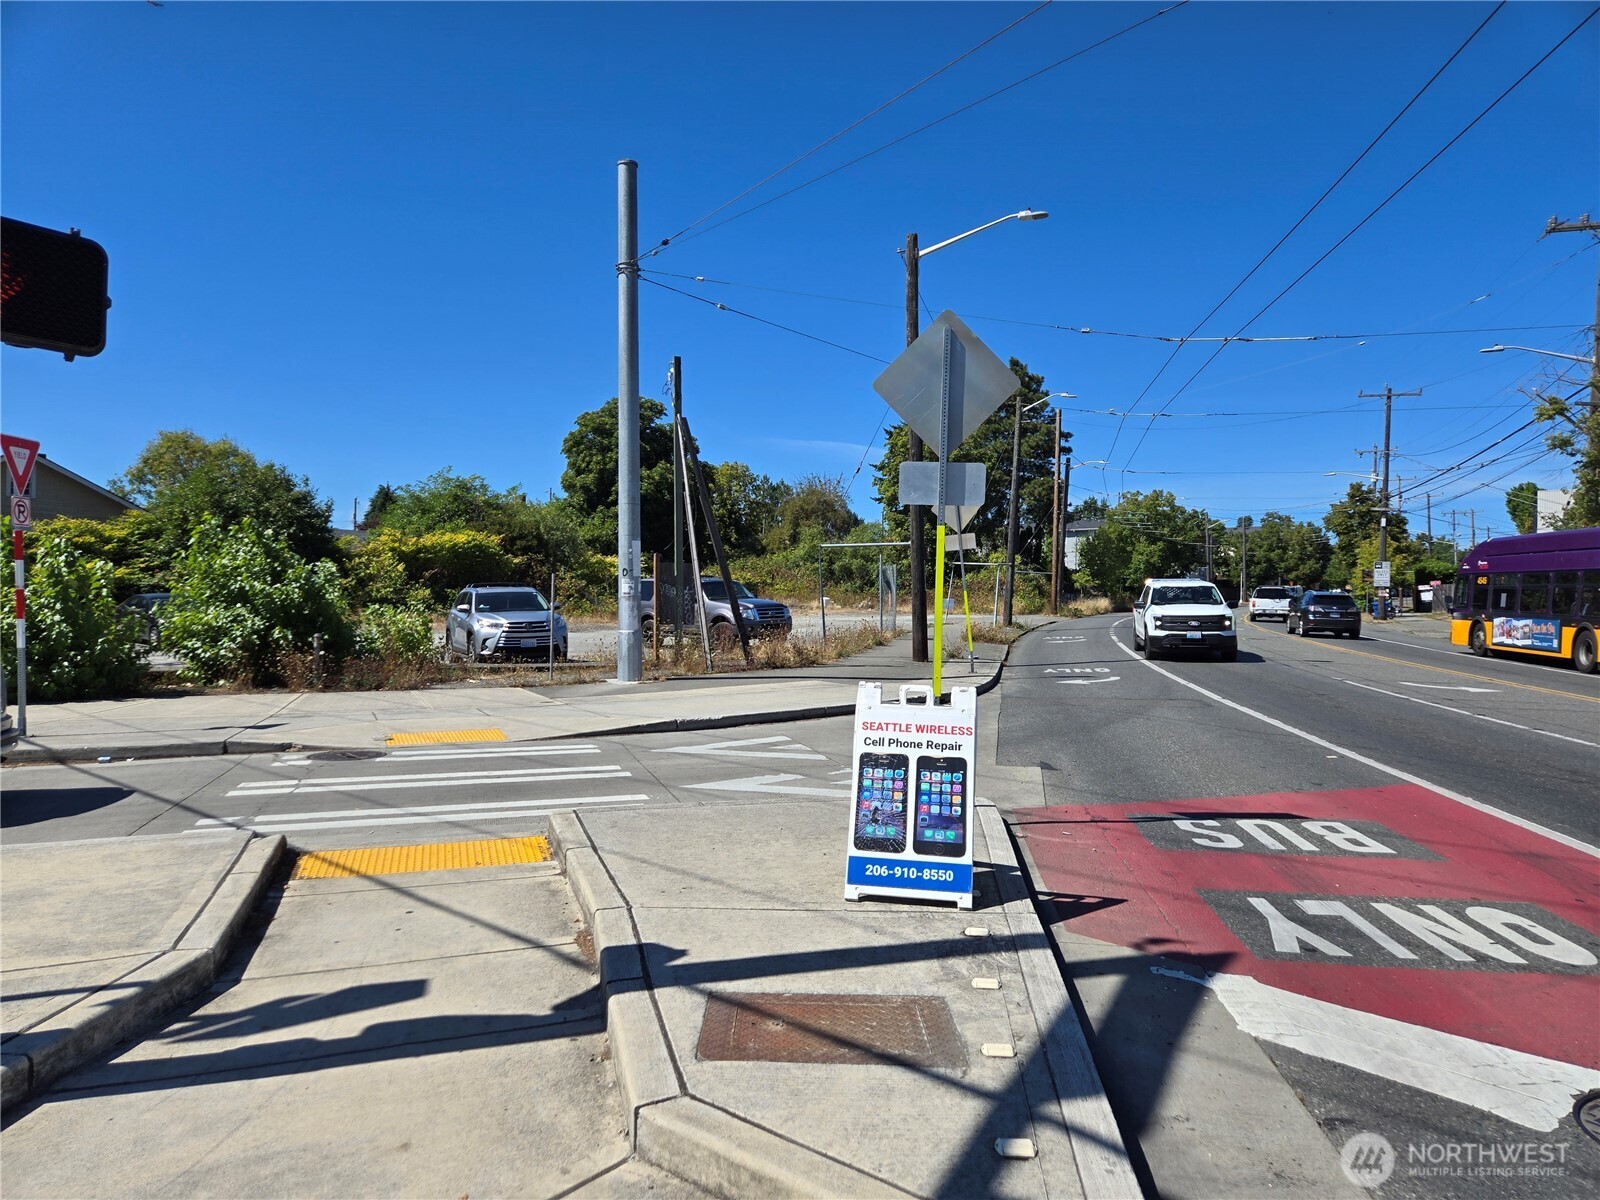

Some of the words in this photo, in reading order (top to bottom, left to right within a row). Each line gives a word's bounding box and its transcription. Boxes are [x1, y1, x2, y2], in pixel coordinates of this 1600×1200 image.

[14, 450, 26, 460] YIELD
[862, 721, 912, 733] SEATTLE
[915, 724, 973, 736] WIRELESS
[864, 737, 885, 747] Cell
[888, 738, 923, 749] Phone
[926, 740, 963, 752] Repair
[1173, 819, 1397, 854] BUS
[865, 864, 954, 882] 206-910-8550
[1247, 897, 1598, 966] ONLY
